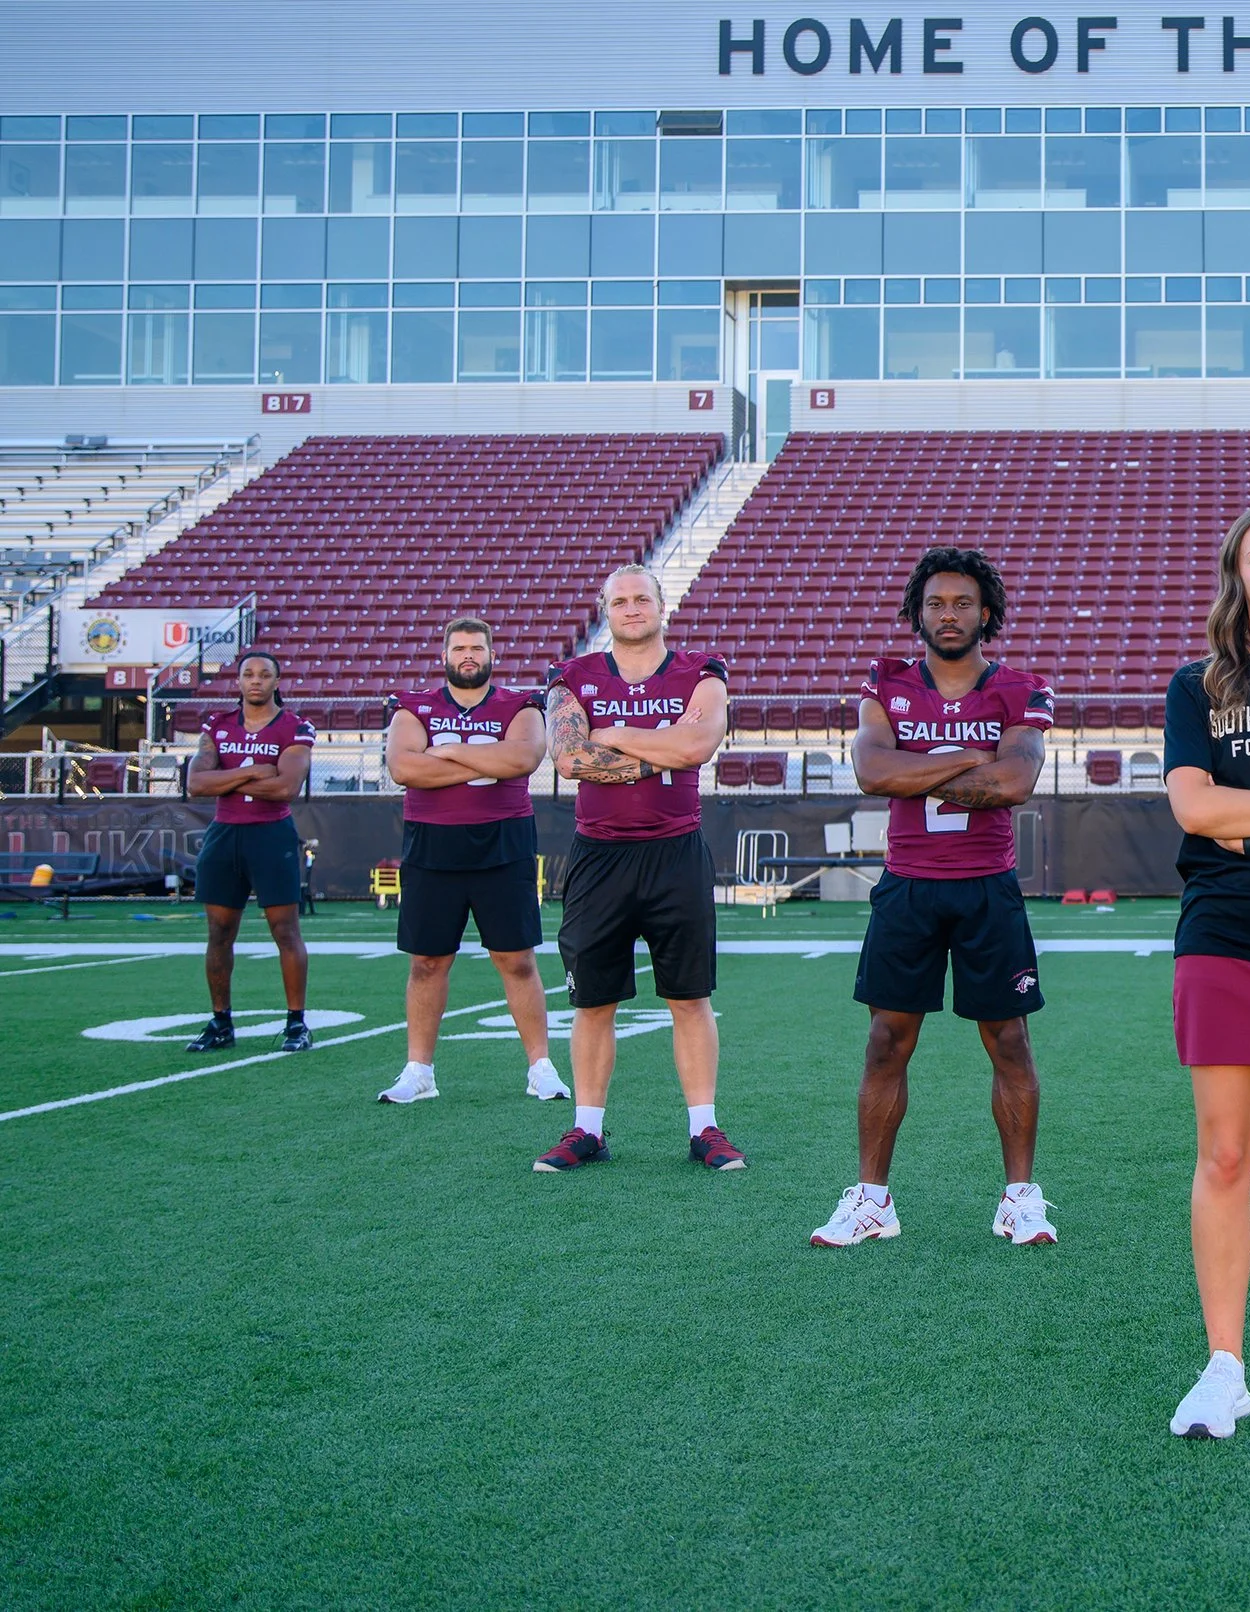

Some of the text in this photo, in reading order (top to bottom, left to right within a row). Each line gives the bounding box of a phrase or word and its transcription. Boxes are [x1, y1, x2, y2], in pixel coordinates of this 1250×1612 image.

[718, 17, 964, 76] HOME
[1009, 16, 1118, 74] OF
[695, 392, 707, 408] 7
[815, 391, 829, 406] 6
[113, 670, 127, 685] 8
[592, 698, 684, 716] SALUKIS
[429, 717, 502, 733] SALUKIS
[898, 721, 1001, 741] SALUKIS
[219, 742, 280, 756] SALUKIS
